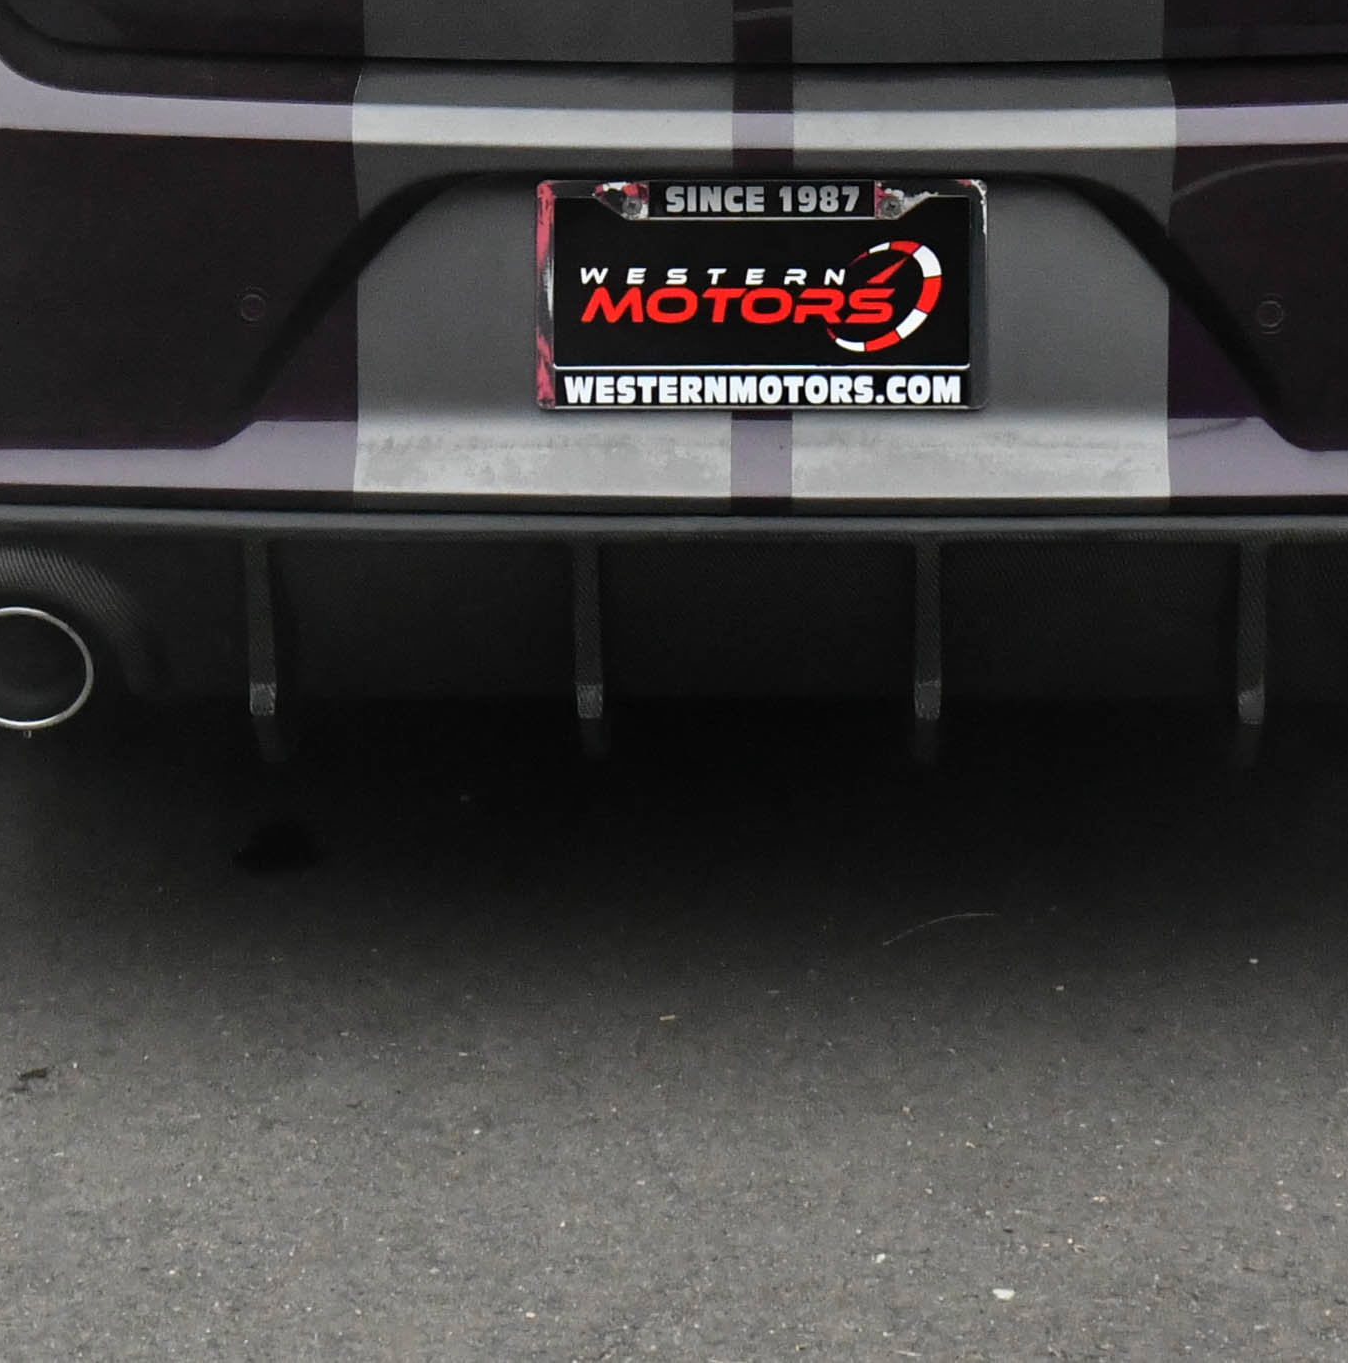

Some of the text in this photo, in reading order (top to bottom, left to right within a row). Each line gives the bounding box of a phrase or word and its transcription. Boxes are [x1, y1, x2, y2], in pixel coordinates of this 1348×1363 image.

[665, 186, 860, 213] SINCE 1987
[580, 267, 847, 286] WESTERN
[581, 287, 895, 324] MOTORS
[564, 375, 961, 405] WESTERNMOTORS.COM
